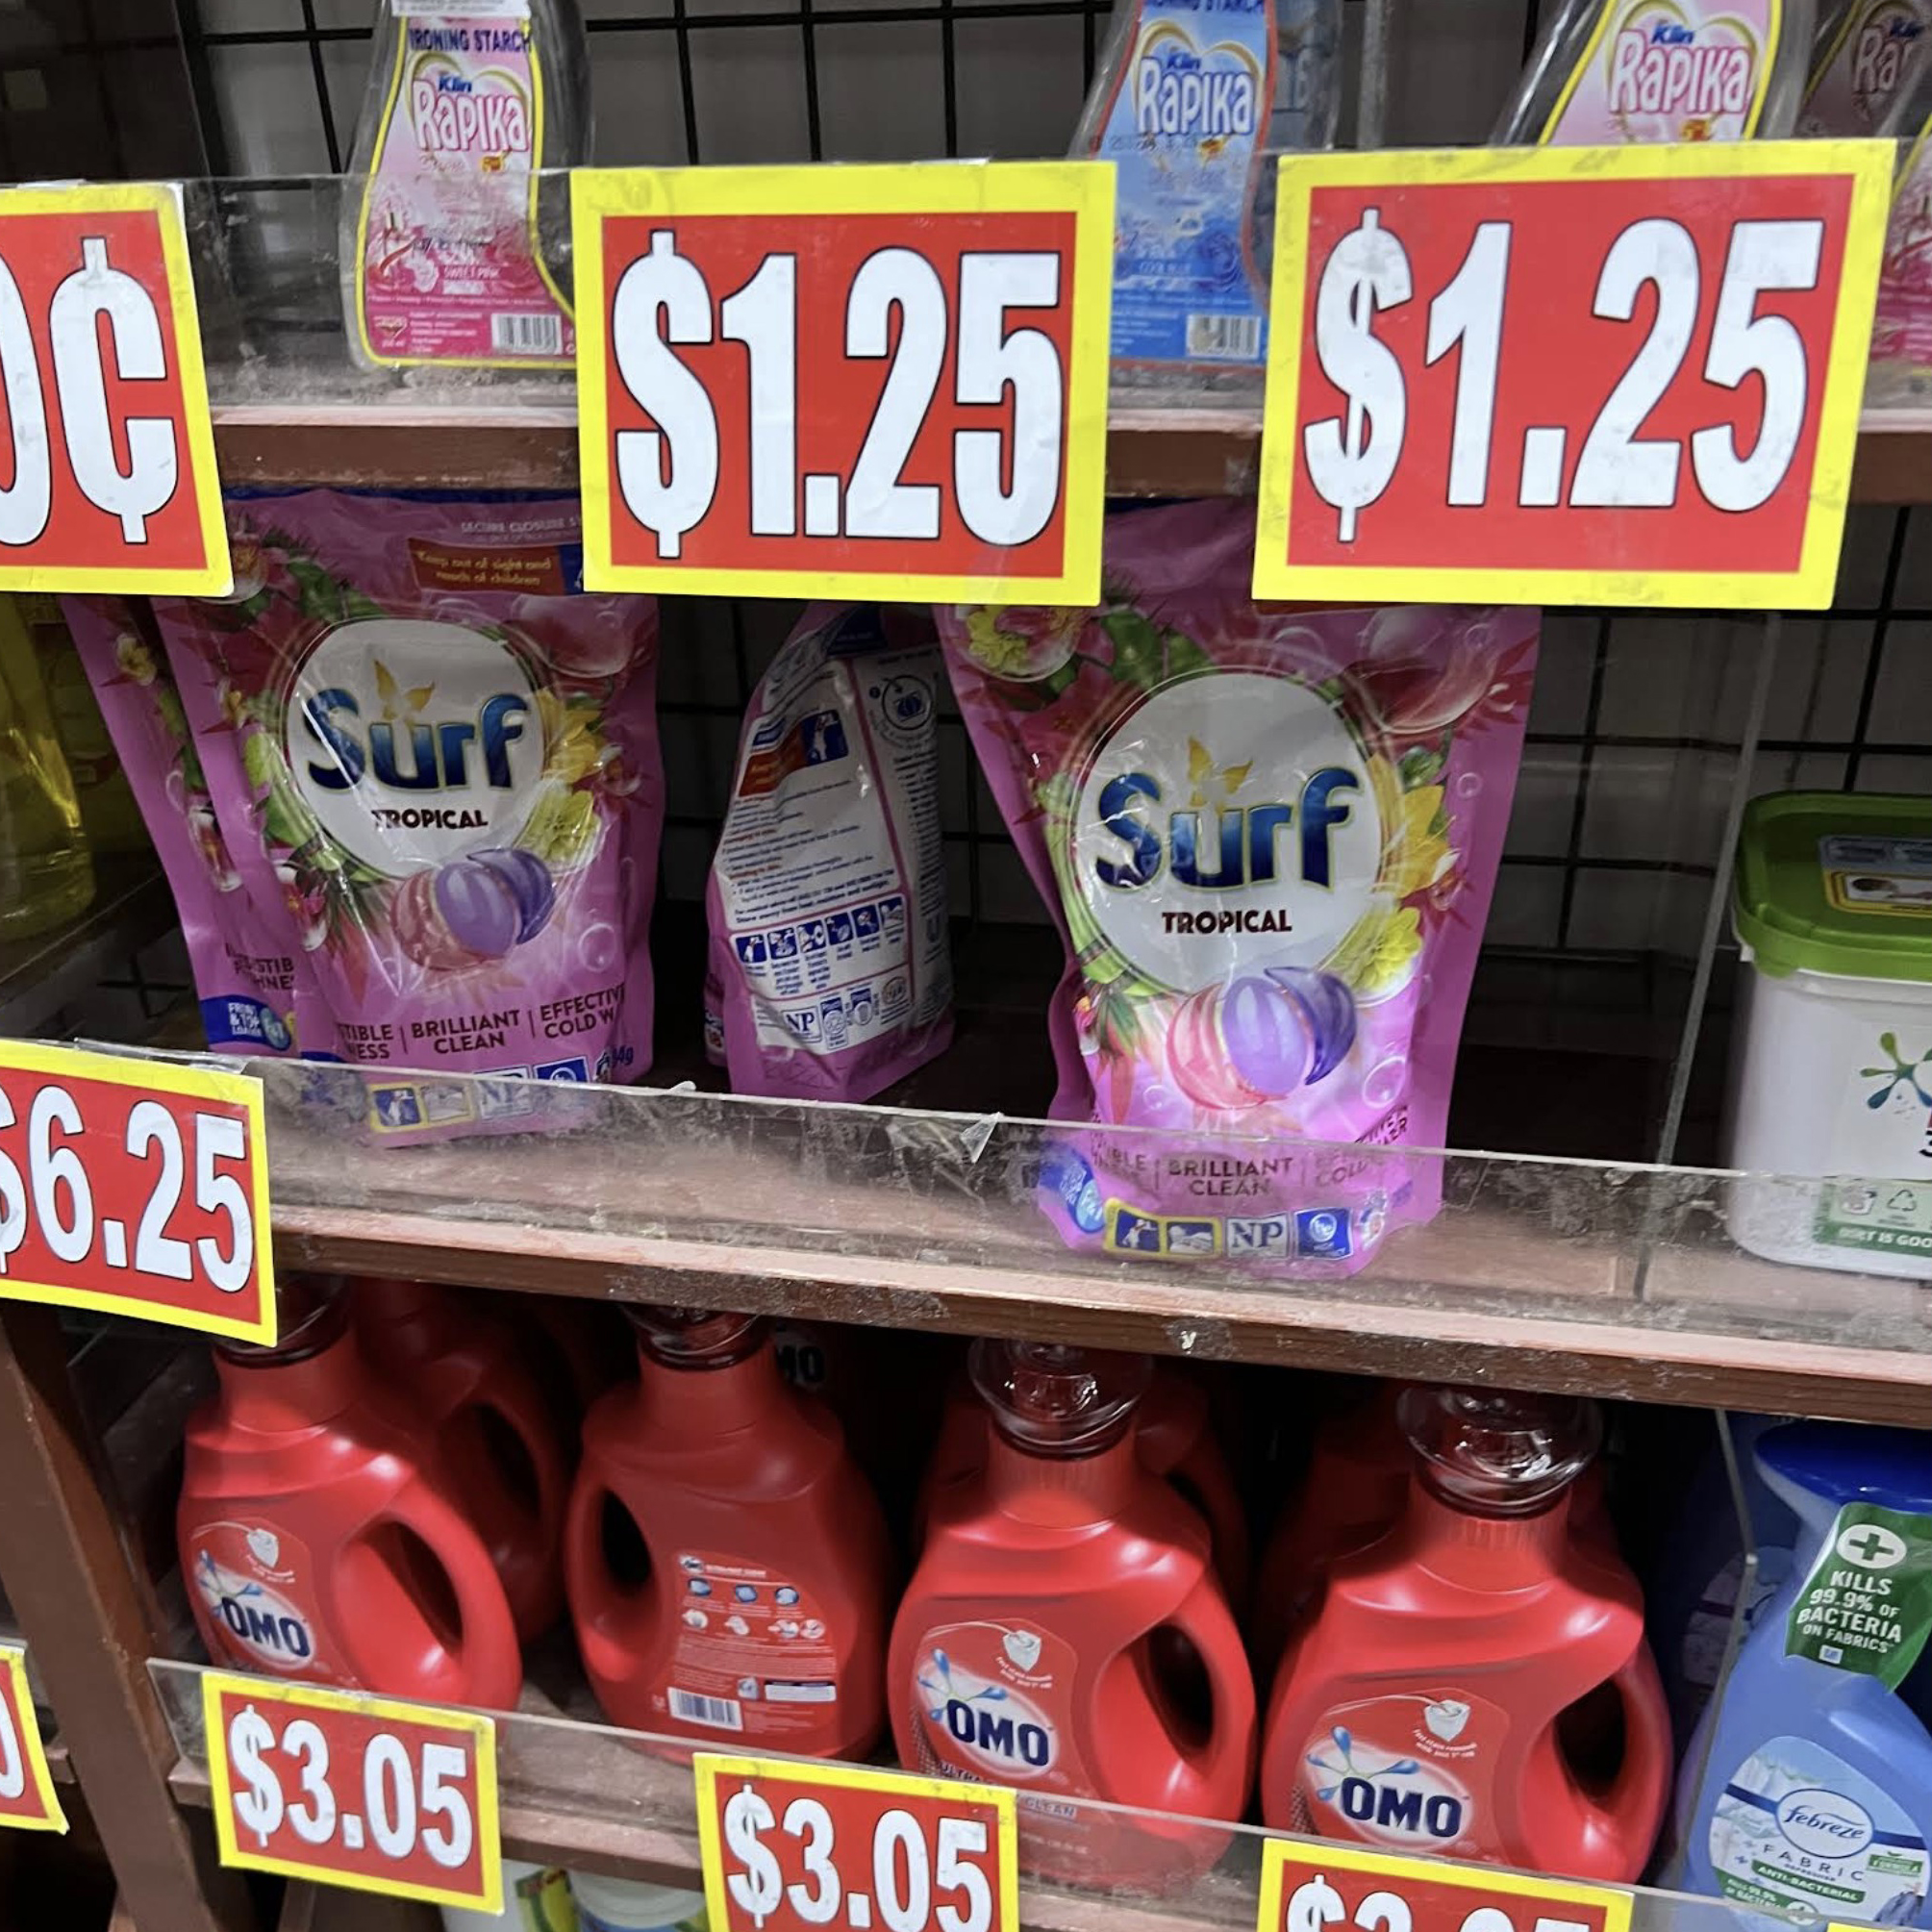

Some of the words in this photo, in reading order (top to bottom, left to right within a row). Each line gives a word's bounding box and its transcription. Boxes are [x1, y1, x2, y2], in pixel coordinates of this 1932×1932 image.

[409, 28, 469, 51] IRONING
[1303, 206, 1825, 543] $1.25
[613, 229, 1064, 560] $1.25
[302, 687, 532, 791] Surf
[370, 808, 489, 830] TROPICAL
[1093, 766, 1366, 893] Surf
[1161, 908, 1293, 935] TROPICAL
[411, 1008, 520, 1040] BRILLIANT
[434, 1031, 506, 1055] CLEAN
[544, 1013, 597, 1039] COLD
[1168, 1157, 1294, 1179] BRILLIANT
[1187, 1178, 1274, 1198] CLEAN
[1231, 1220, 1284, 1249] NP
[1878, 1231, 1893, 1243] IS
[1830, 1570, 1893, 1595] KILLS
[1809, 1588, 1873, 1613] 99.9%
[1878, 1603, 1901, 1618] OF
[221, 1596, 312, 1658] OMO
[1796, 1606, 1902, 1643] BACTERIA
[1802, 1623, 1823, 1637] ON
[946, 1698, 1050, 1767] OMO
[228, 1703, 473, 1869] $3.05
[1024, 1795, 1075, 1817] CLEAN
[1341, 1776, 1463, 1838] OMO
[1783, 1804, 1866, 1840] febreze
[723, 1784, 993, 1932] $3.05
[1763, 1844, 1866, 1882] FABRIC
[1758, 1866, 1859, 1901] ANTI-BACTERIAL
